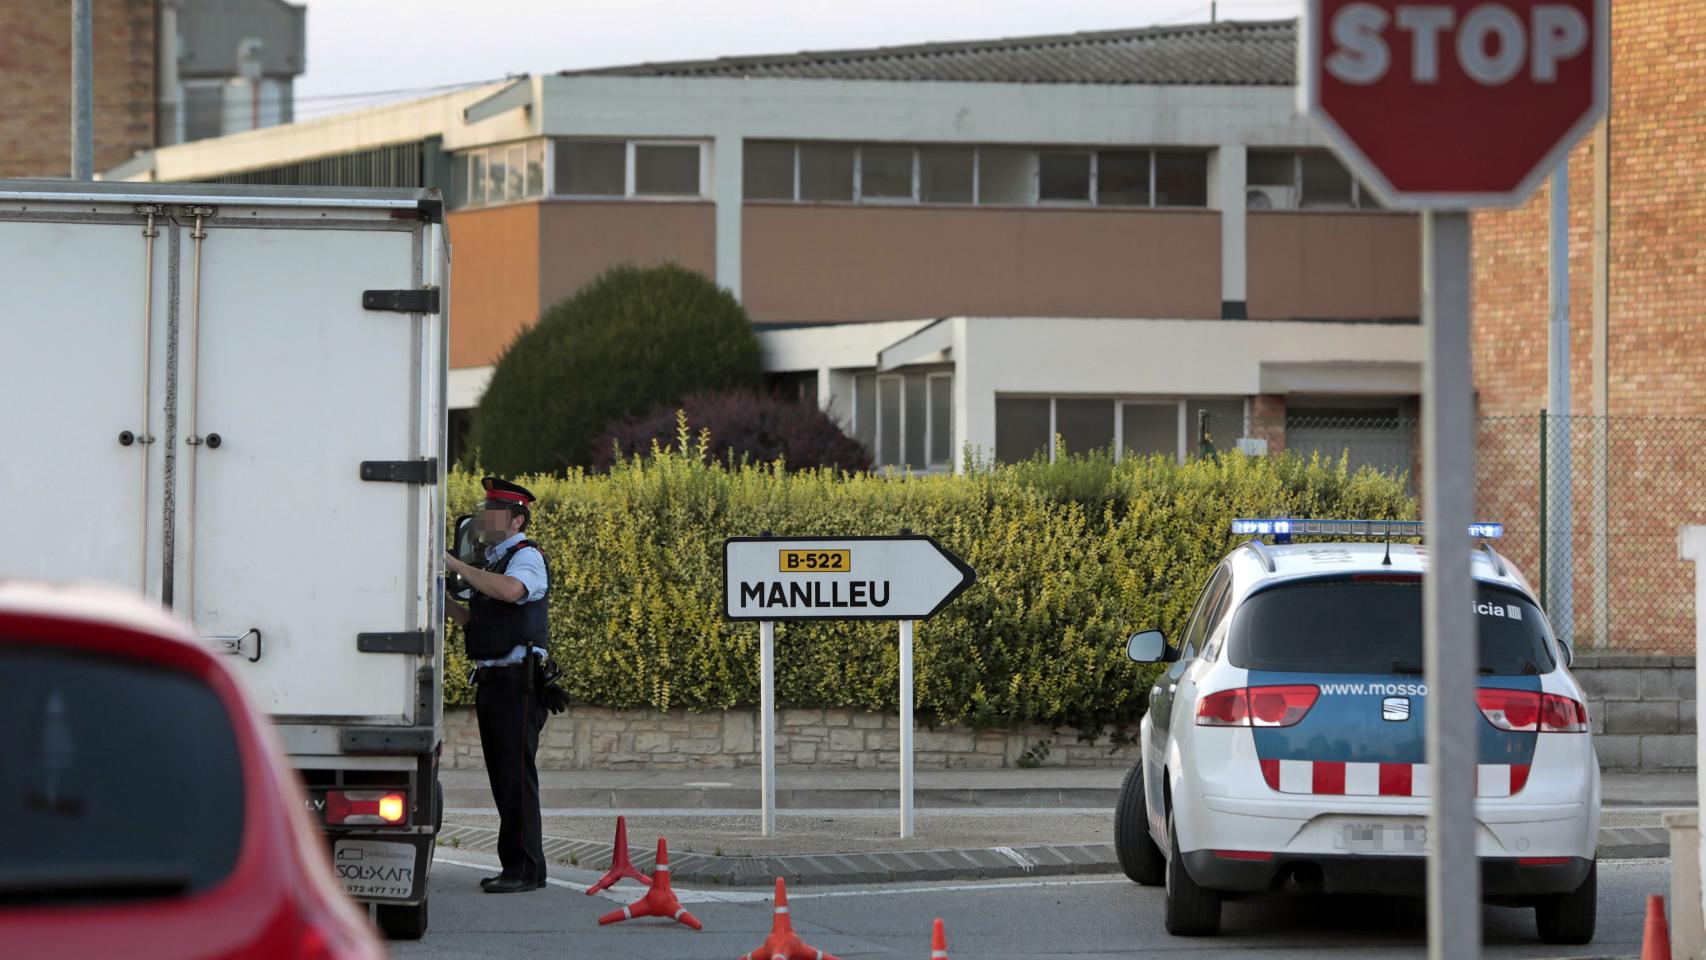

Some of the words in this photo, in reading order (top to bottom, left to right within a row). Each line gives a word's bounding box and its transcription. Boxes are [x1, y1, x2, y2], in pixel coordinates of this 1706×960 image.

[1324, 2, 1590, 86] STOP
[787, 553, 843, 569] B-522
[740, 581, 890, 608] MANLLEU
[1320, 684, 1431, 696] www.mosso
